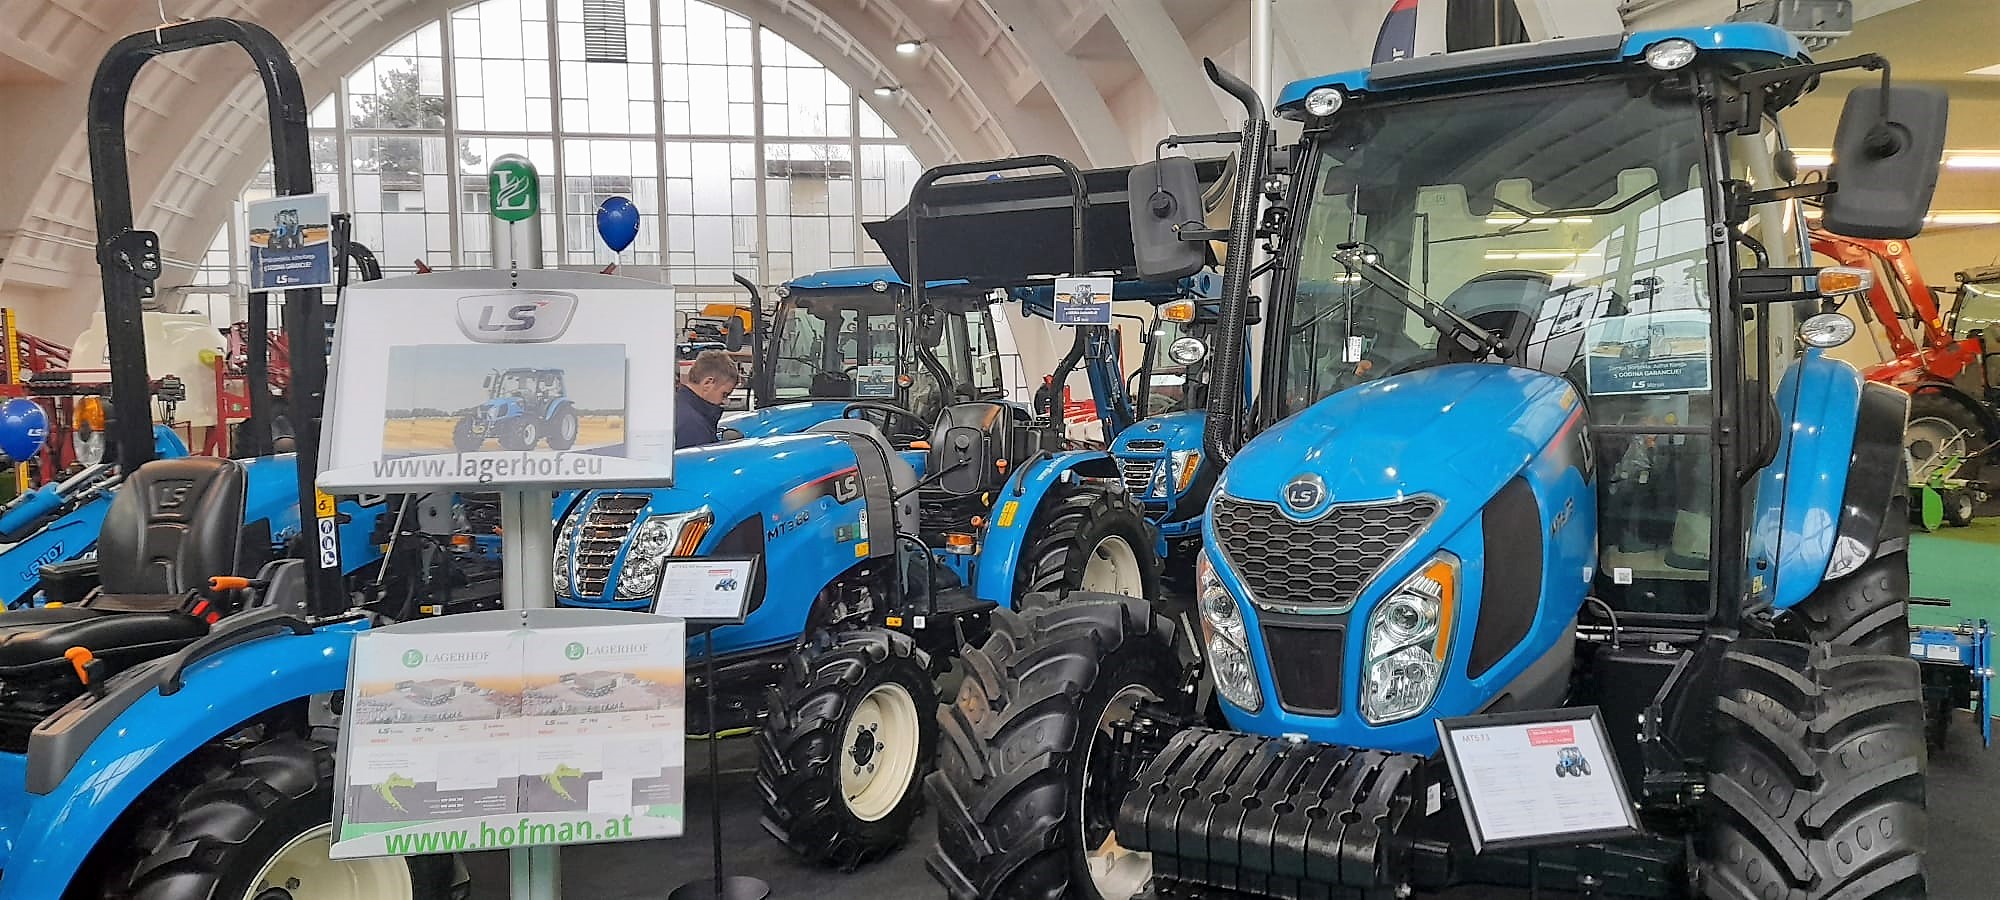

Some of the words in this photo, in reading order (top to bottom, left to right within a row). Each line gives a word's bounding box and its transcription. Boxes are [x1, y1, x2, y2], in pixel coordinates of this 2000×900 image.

[478, 305, 537, 331] LS
[1632, 381, 1646, 389] LS
[373, 452, 603, 483] www.lagerhof.eu
[834, 475, 858, 503] LS
[1291, 490, 1312, 502] LS
[425, 651, 489, 664] LAGERHOF
[586, 643, 649, 656] LAGERHOF
[385, 814, 633, 854] www.hofman.at
